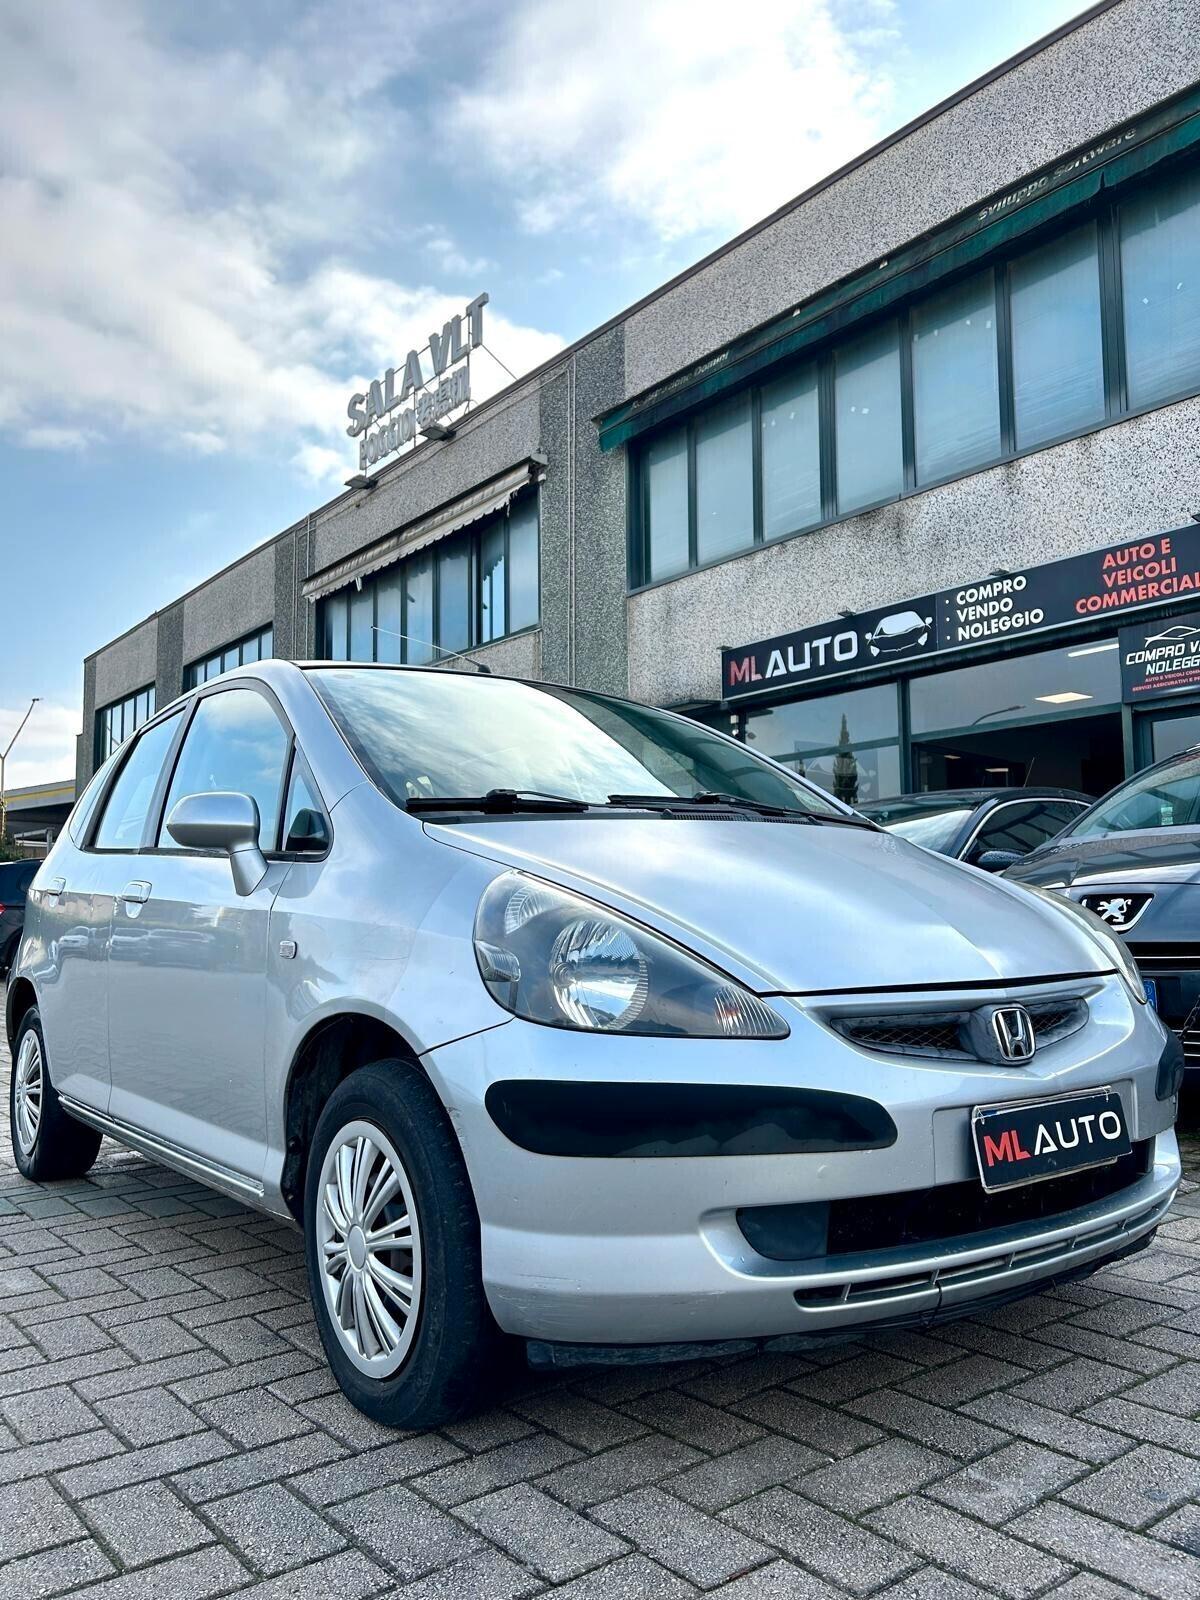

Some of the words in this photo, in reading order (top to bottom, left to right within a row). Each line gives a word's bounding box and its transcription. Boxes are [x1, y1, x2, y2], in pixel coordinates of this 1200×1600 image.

[978, 176, 1049, 222] Sviluppo
[346, 349, 425, 438] SALA
[428, 292, 490, 376] VLT
[1102, 543, 1156, 570] AUTO
[1161, 538, 1171, 555] E
[1102, 557, 1177, 588] VEICOLI
[956, 575, 1027, 606] COMPRO
[956, 598, 1013, 624] VENDO
[957, 608, 1044, 642] NOLEGGIO
[1125, 643, 1186, 666] COMPRO
[1145, 654, 1200, 676] NOLEGG
